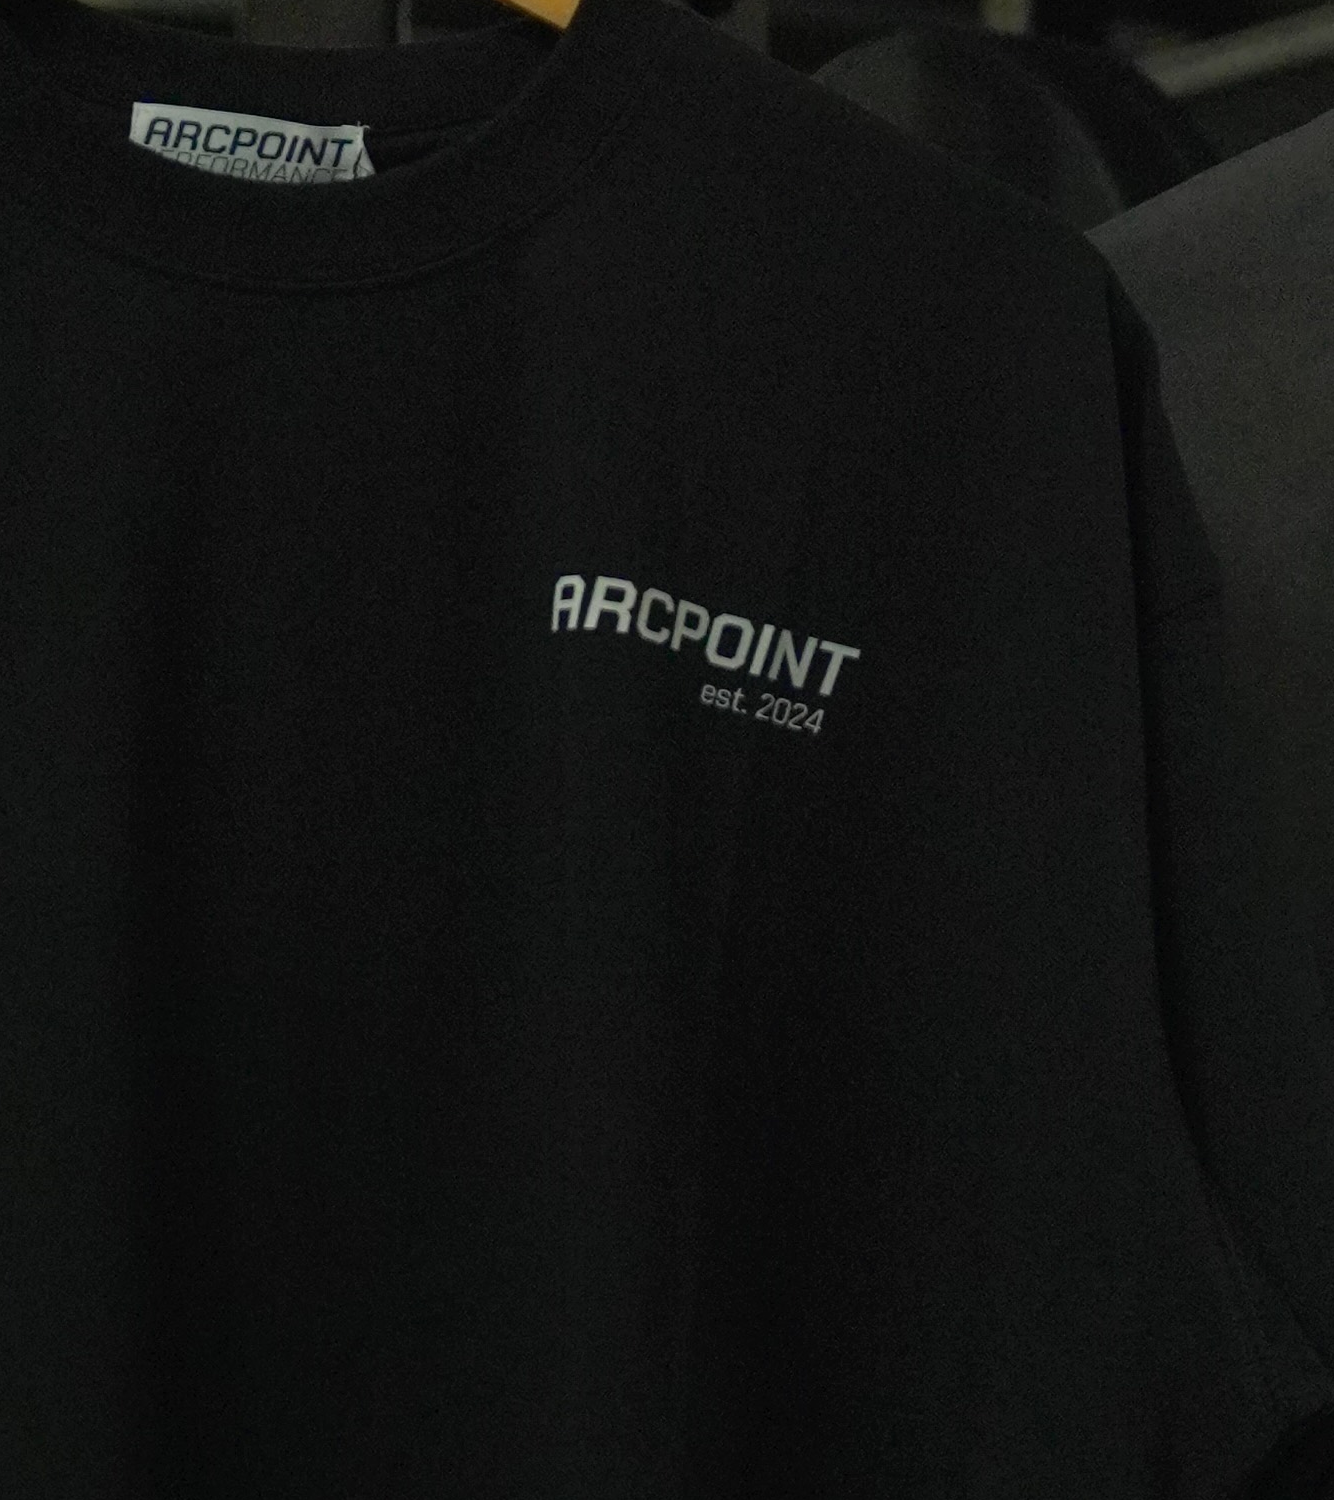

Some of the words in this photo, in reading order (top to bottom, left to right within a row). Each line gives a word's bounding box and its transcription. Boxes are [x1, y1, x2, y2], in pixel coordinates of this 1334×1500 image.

[143, 115, 354, 169] ARCPOINT
[550, 573, 862, 697] ARCPOINT
[700, 683, 748, 715] est.
[754, 693, 826, 735] 2024
